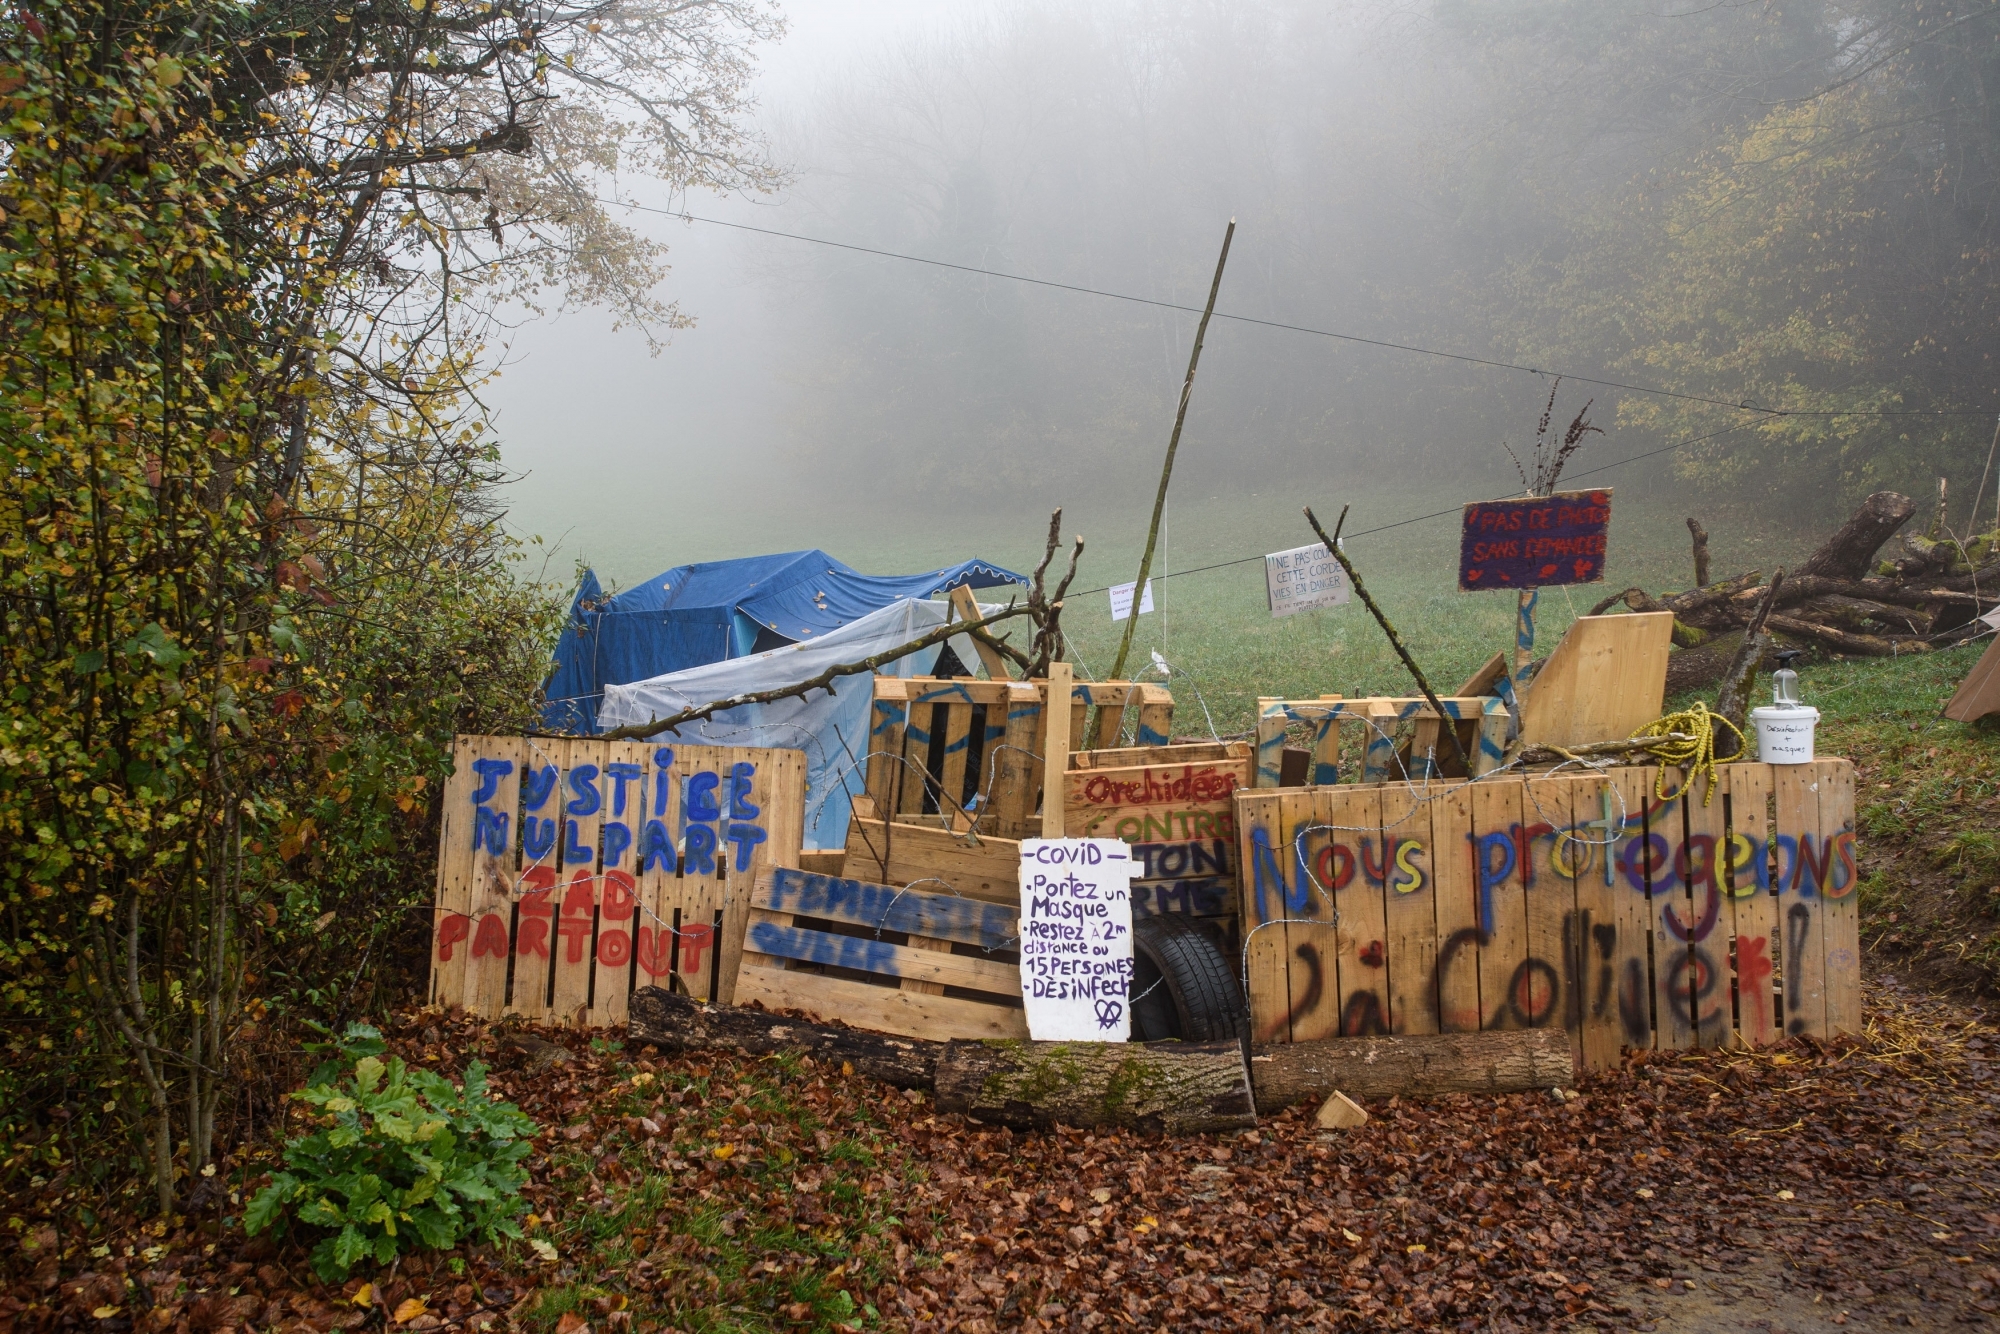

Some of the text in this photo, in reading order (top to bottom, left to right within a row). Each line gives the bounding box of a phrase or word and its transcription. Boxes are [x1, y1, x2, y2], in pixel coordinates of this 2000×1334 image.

[1481, 511, 1523, 532] PAS
[1528, 508, 1553, 530] DE
[1473, 541, 1519, 562] SANS
[1276, 562, 1342, 583] CETTE CORDE
[1273, 576, 1341, 598] VIES EN DANGER
[1772, 746, 1805, 755] masques
[1084, 765, 1237, 804] Orchidées
[518, 865, 636, 921] ZAD
[1034, 871, 1126, 901] Portez un
[1031, 895, 1109, 925] Masque
[1029, 920, 1085, 941] Restez
[438, 912, 715, 977] PARTOUT
